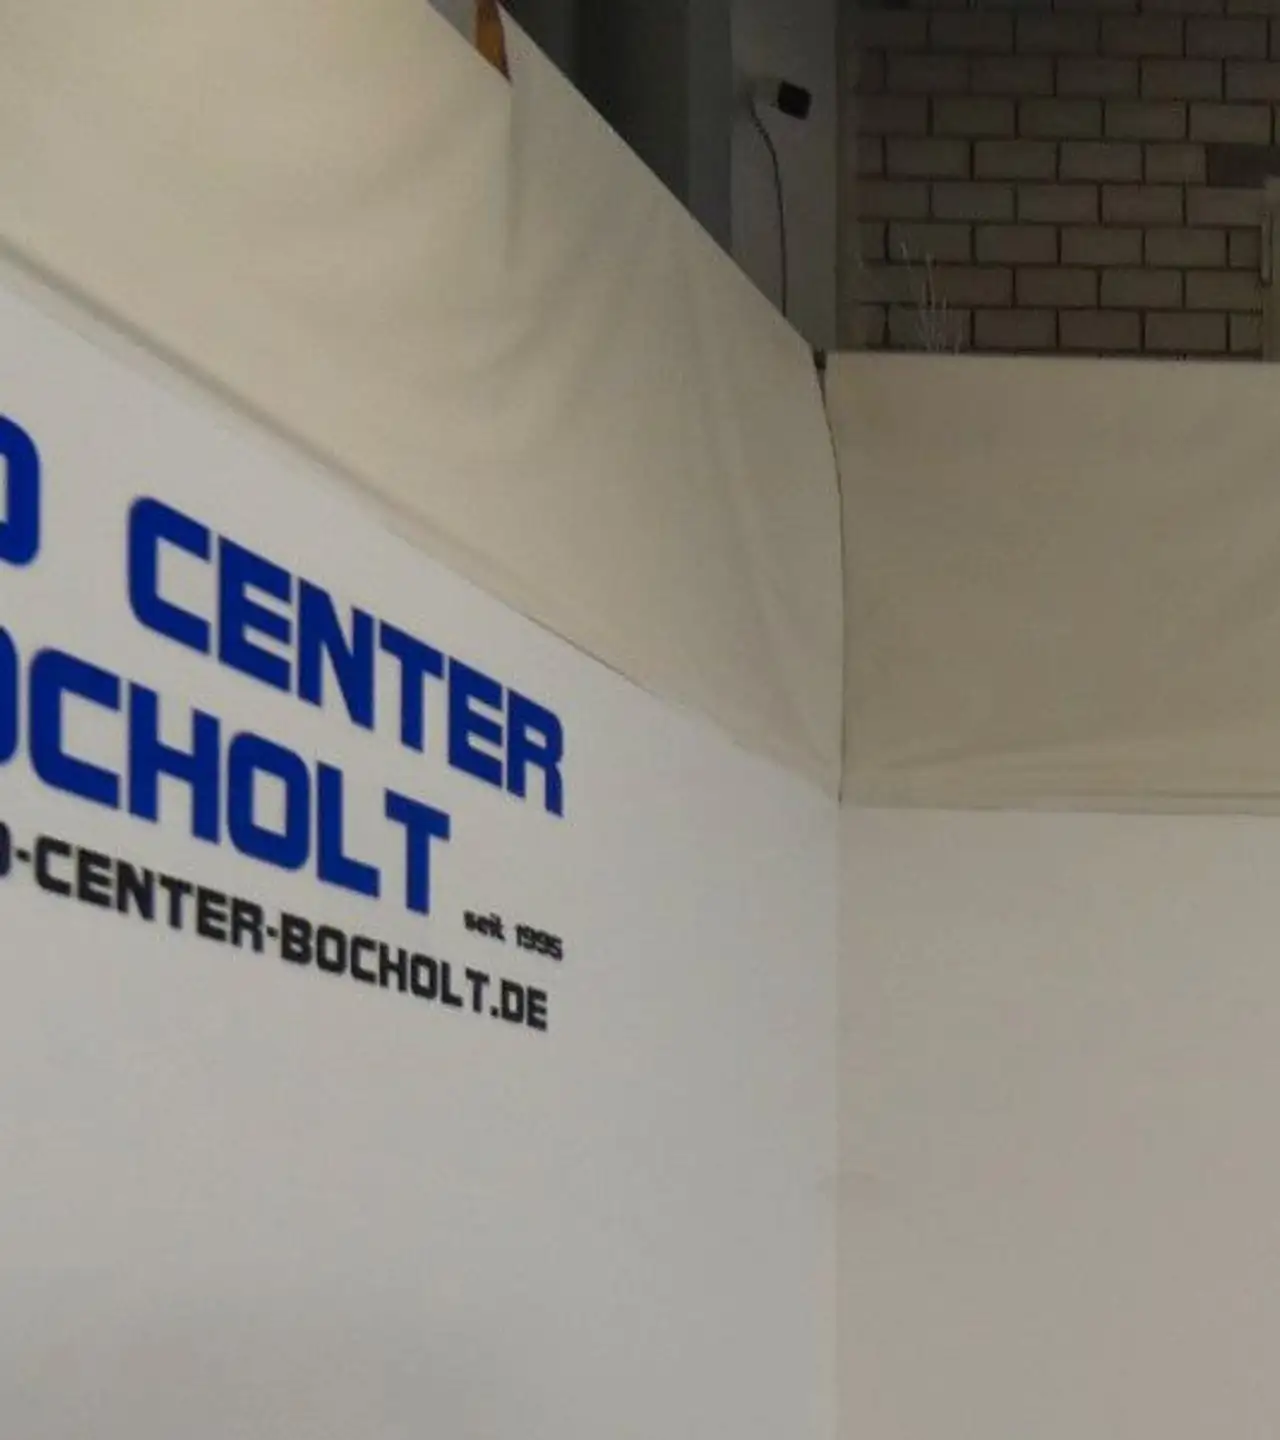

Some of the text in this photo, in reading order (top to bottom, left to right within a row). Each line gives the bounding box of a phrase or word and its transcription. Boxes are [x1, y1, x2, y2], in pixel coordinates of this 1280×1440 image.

[0, 628, 563, 961] CHOLT seit 1995
[127, 497, 565, 817] CENTER
[0, 820, 548, 1032] -CENTER-BOCHOLT.DE
